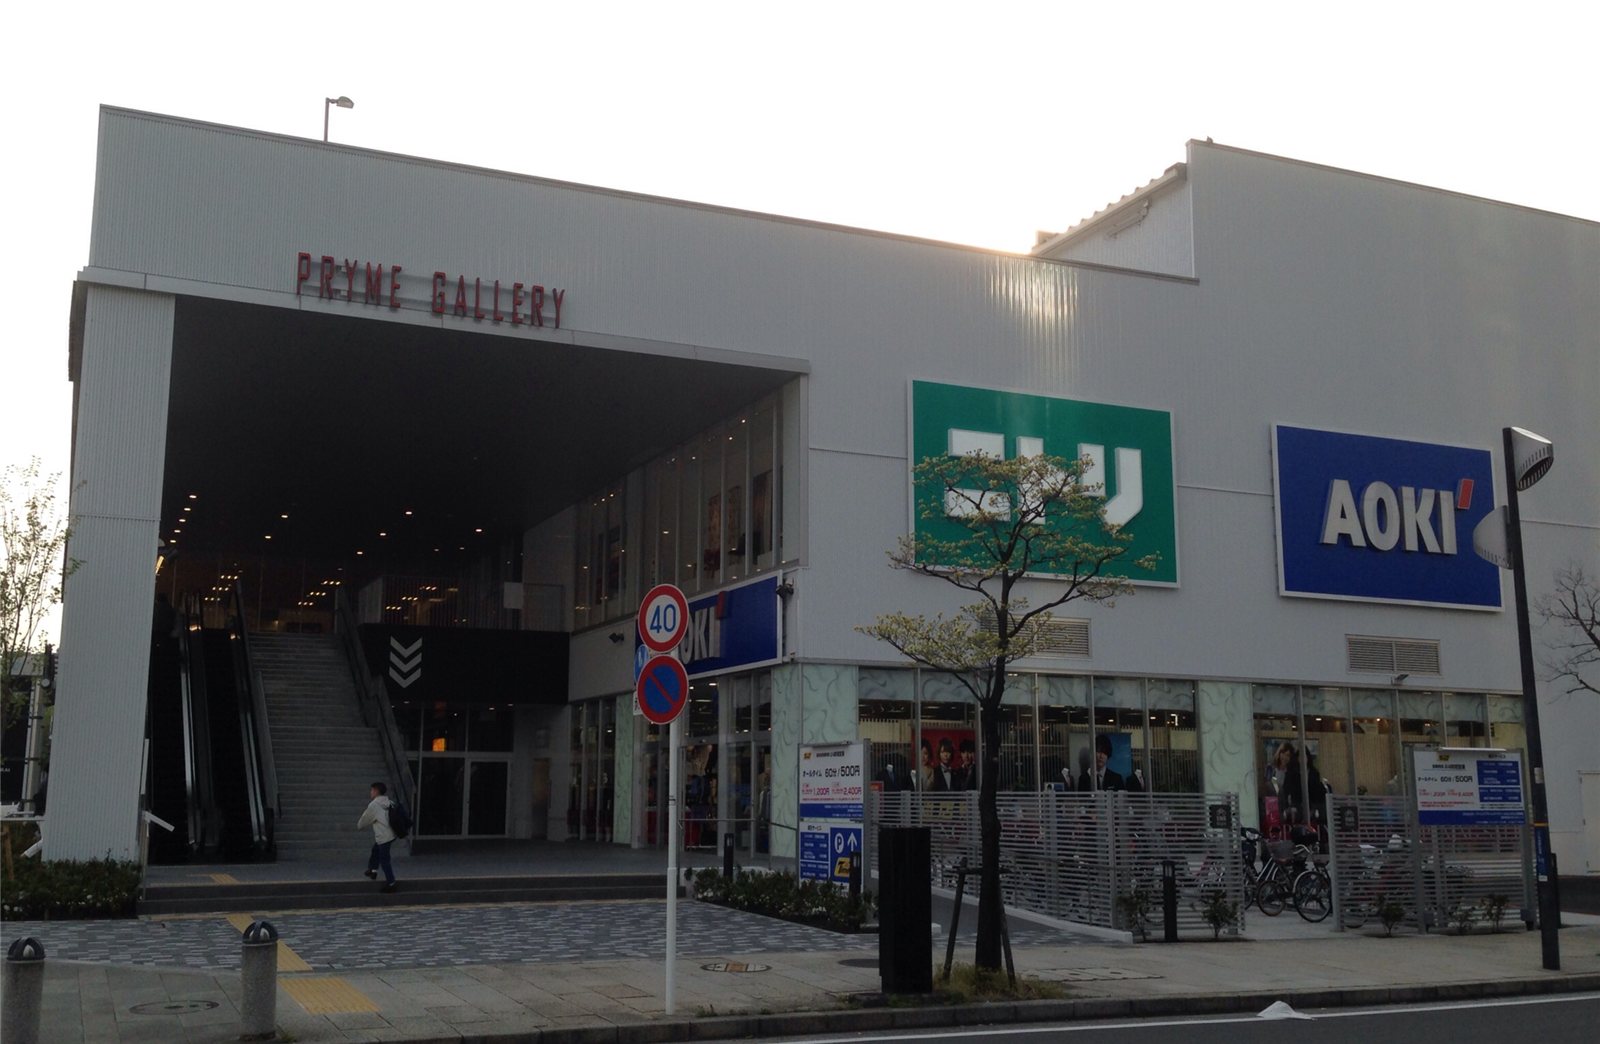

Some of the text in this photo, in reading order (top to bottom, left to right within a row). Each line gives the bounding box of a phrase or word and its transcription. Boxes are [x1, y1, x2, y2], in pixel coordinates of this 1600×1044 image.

[297, 252, 565, 328] PRYME GALLERY
[944, 428, 1143, 531] ニトリ
[1321, 478, 1458, 554] AOKI
[650, 604, 676, 633] 40
[837, 836, 843, 851] P
